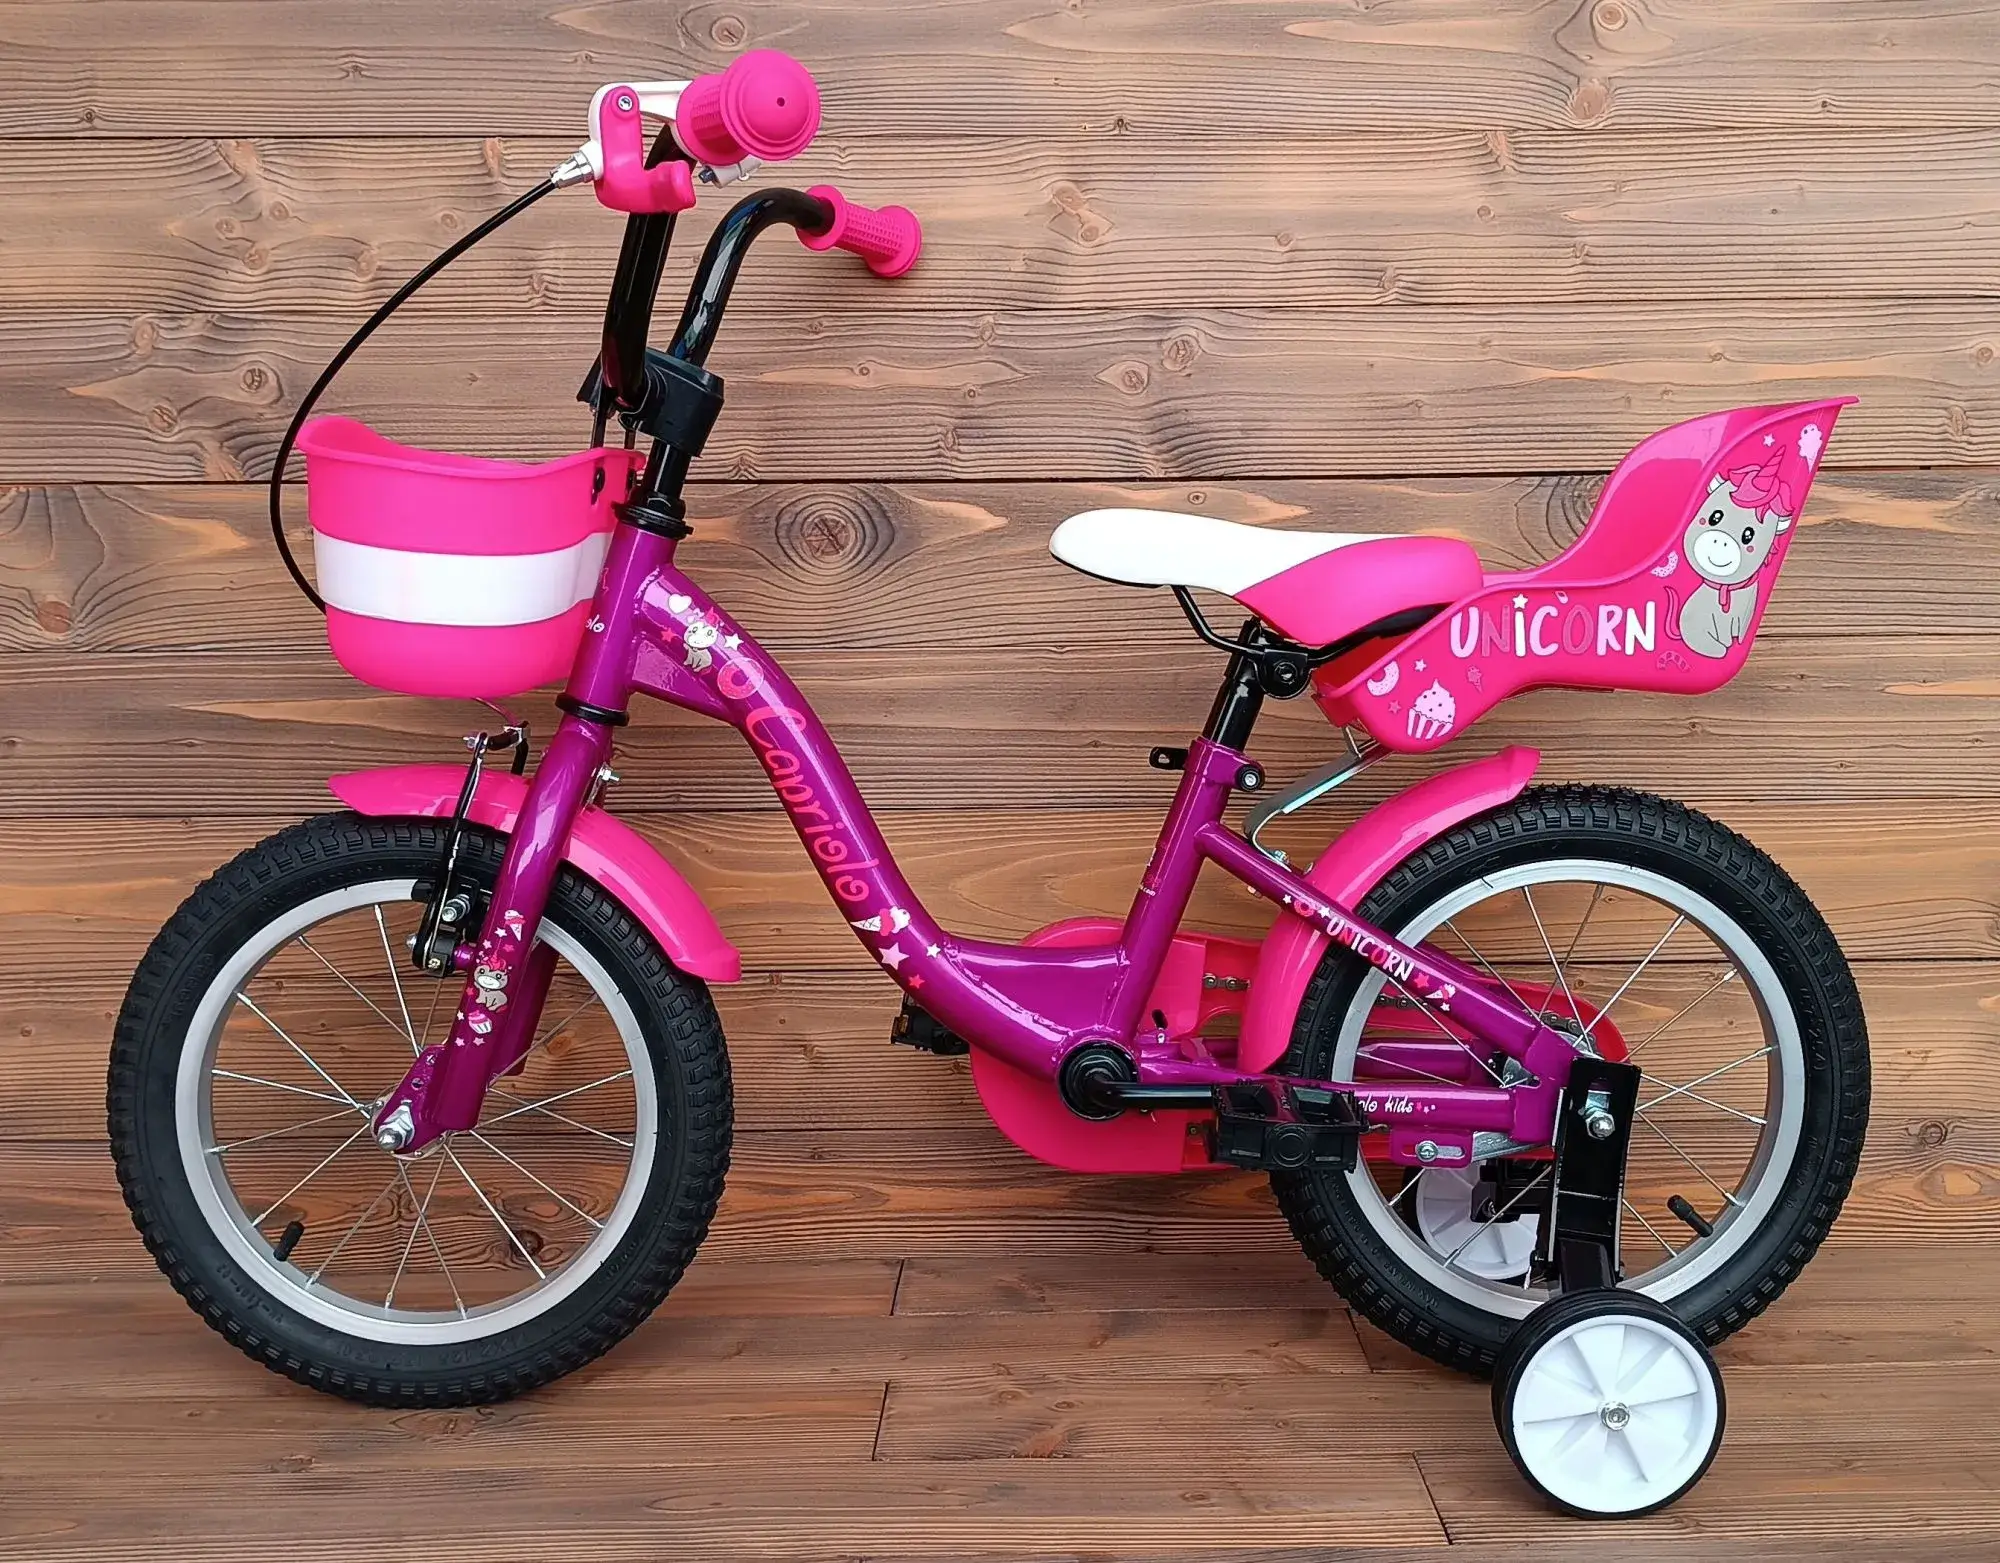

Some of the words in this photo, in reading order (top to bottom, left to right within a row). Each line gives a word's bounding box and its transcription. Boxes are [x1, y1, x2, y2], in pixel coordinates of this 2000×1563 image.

[745, 705, 880, 902] Capriolo
[1325, 916, 1416, 983] UNICORN
[1384, 1093, 1415, 1113] kids
